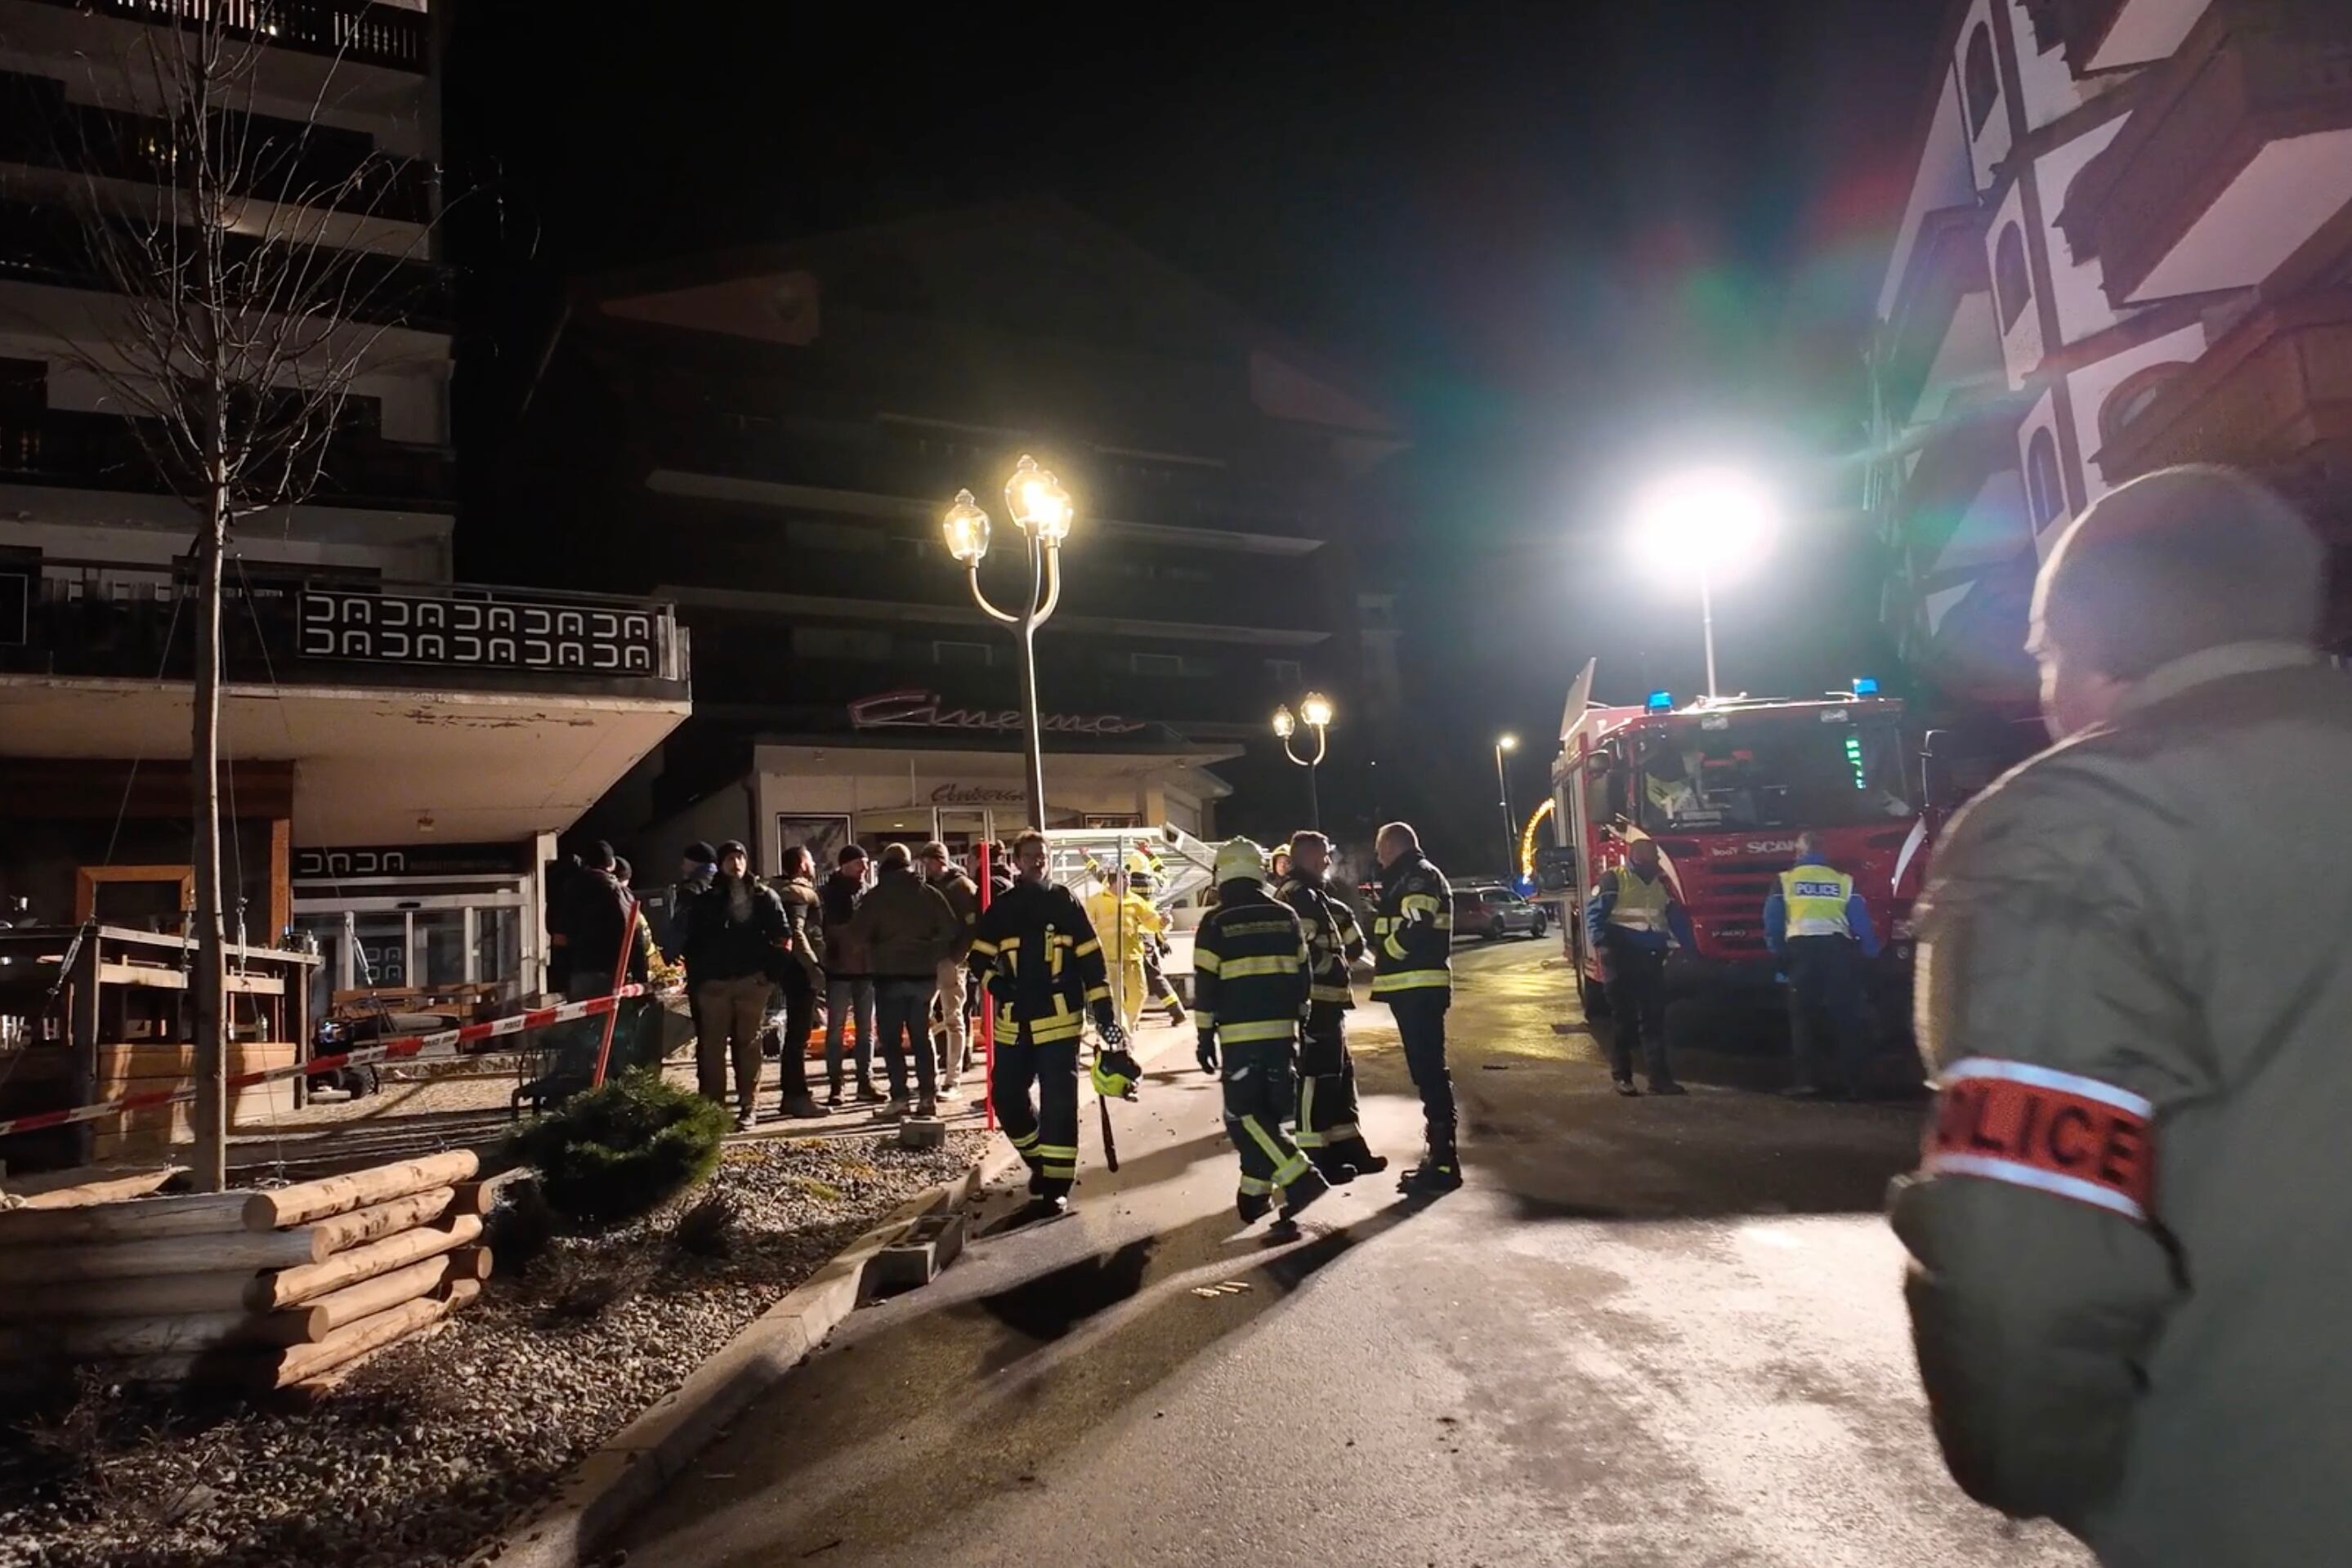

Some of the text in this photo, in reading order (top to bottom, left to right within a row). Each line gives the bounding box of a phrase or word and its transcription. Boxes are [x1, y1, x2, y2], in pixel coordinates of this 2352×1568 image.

[847, 690, 1147, 735] Cinema
[1796, 882, 1840, 897] POLICE
[1938, 1088, 2141, 1185] LICE
